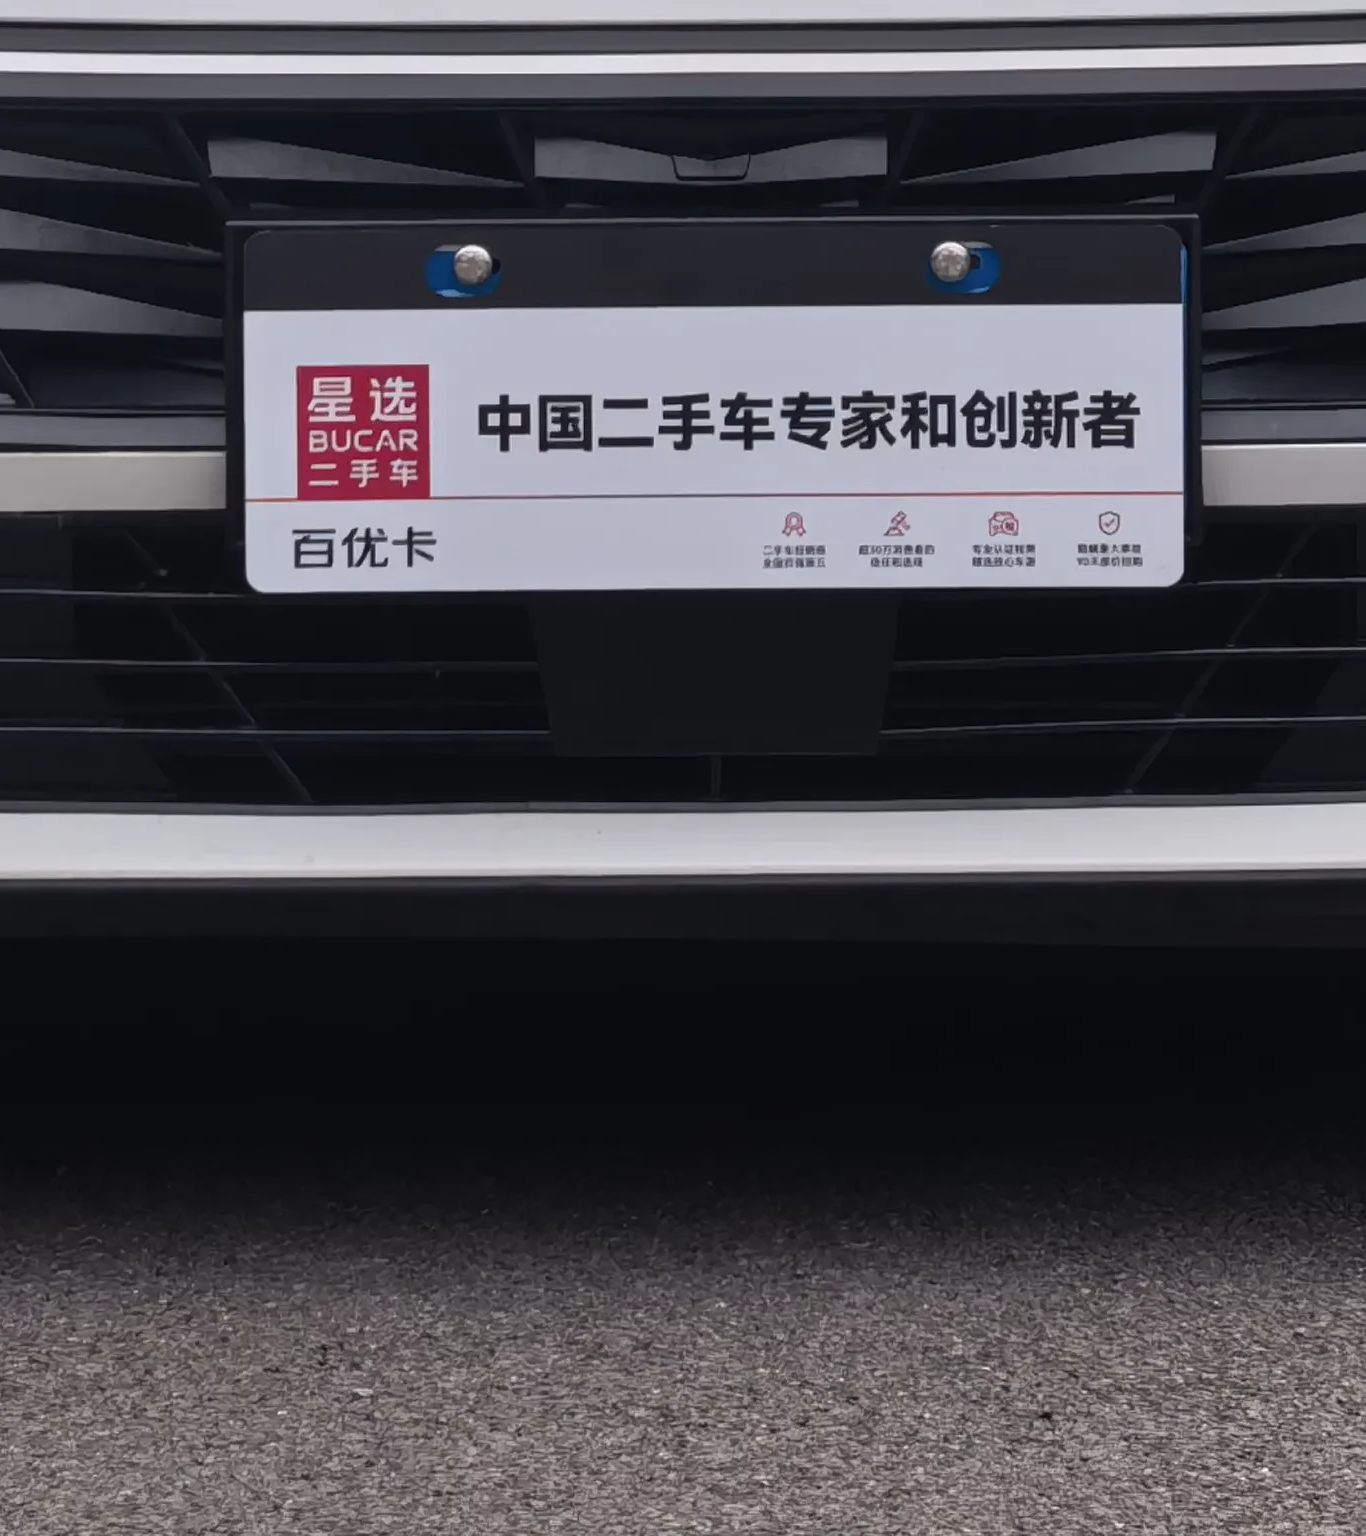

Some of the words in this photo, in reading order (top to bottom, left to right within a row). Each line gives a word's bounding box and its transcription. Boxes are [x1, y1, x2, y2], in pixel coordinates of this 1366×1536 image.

[307, 375, 417, 423] 星选
[308, 429, 418, 453] BUCAR
[477, 388, 1142, 454] 中国二手车专家和创新者
[308, 458, 419, 488] 二手车
[292, 526, 437, 569] 百优卡
